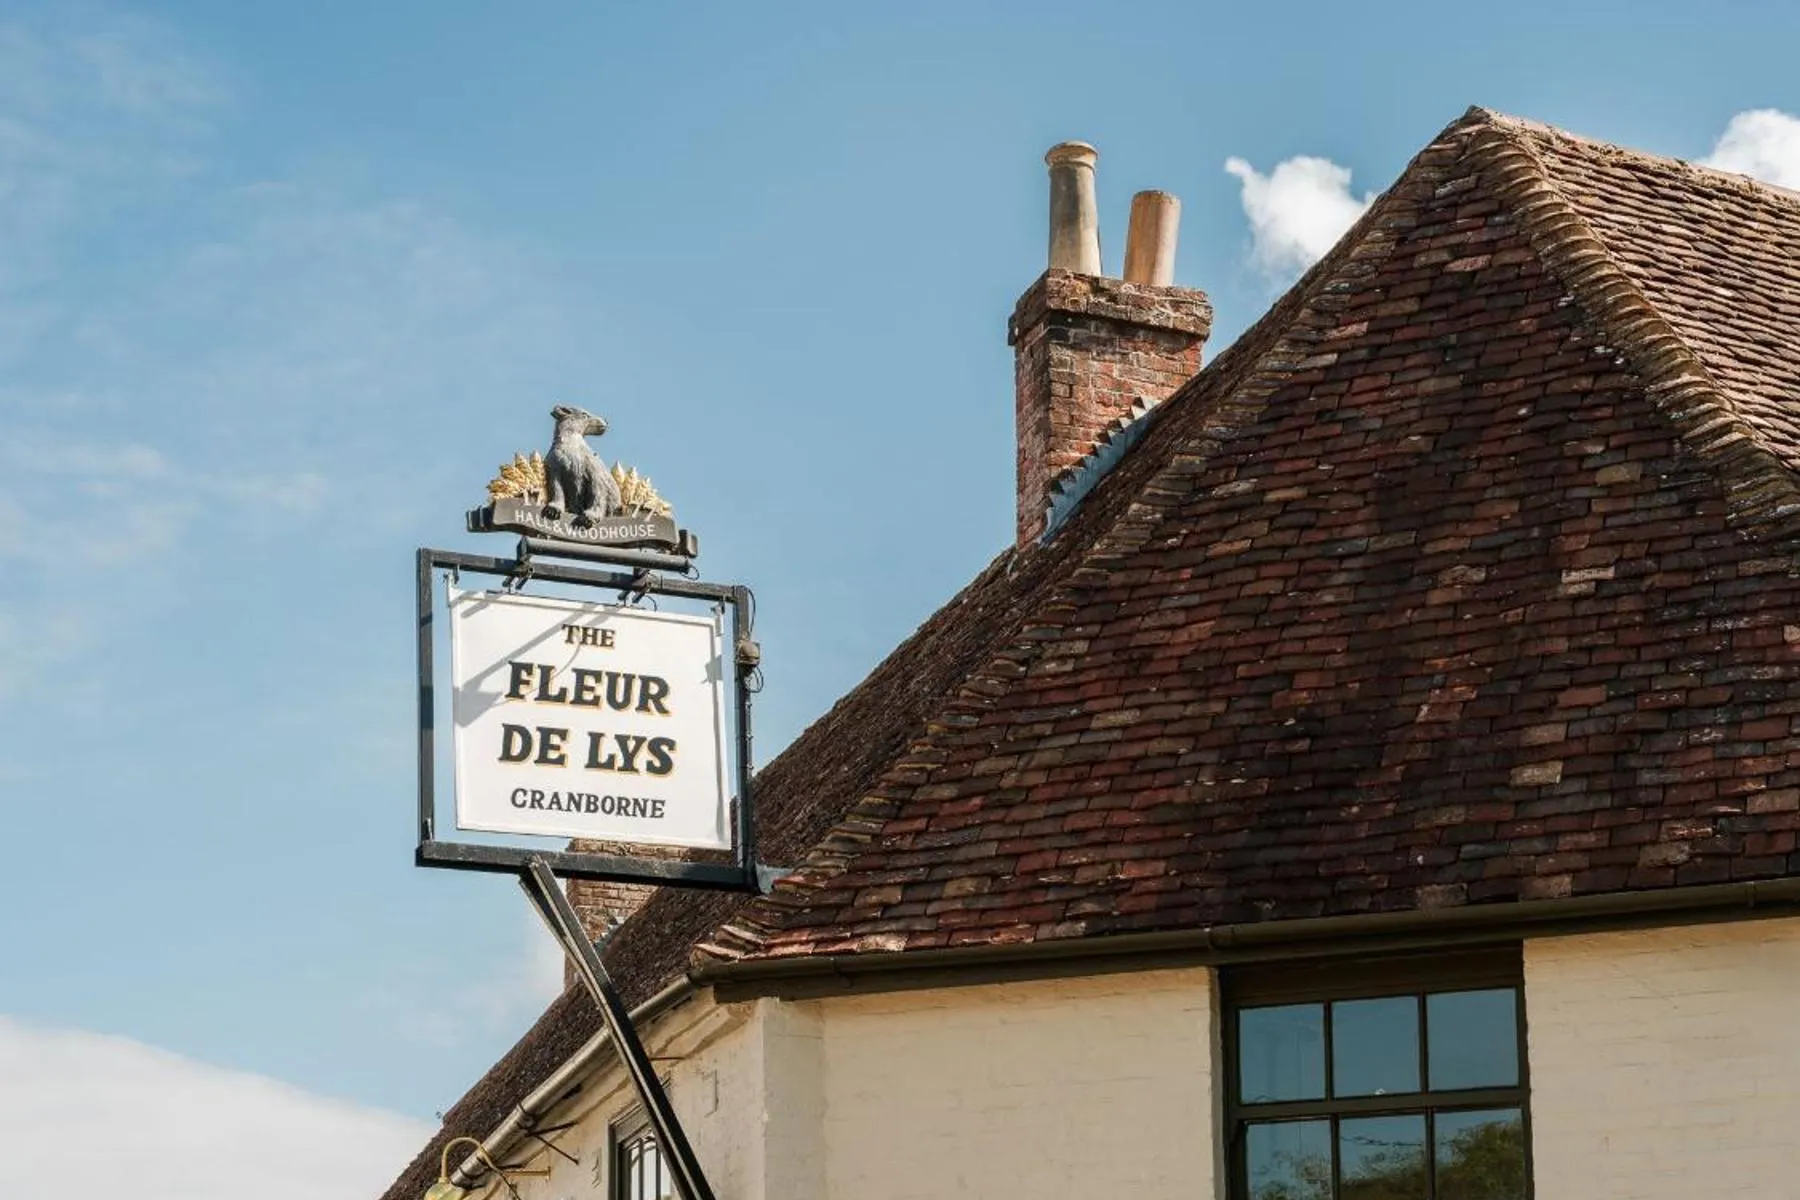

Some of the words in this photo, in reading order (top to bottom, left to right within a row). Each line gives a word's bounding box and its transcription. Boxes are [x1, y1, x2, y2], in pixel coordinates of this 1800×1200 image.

[562, 623, 616, 649] THE
[504, 660, 672, 716] FLEUR
[499, 723, 569, 768] DE
[584, 731, 677, 778] LYS
[511, 788, 666, 819] CRANBORNE
